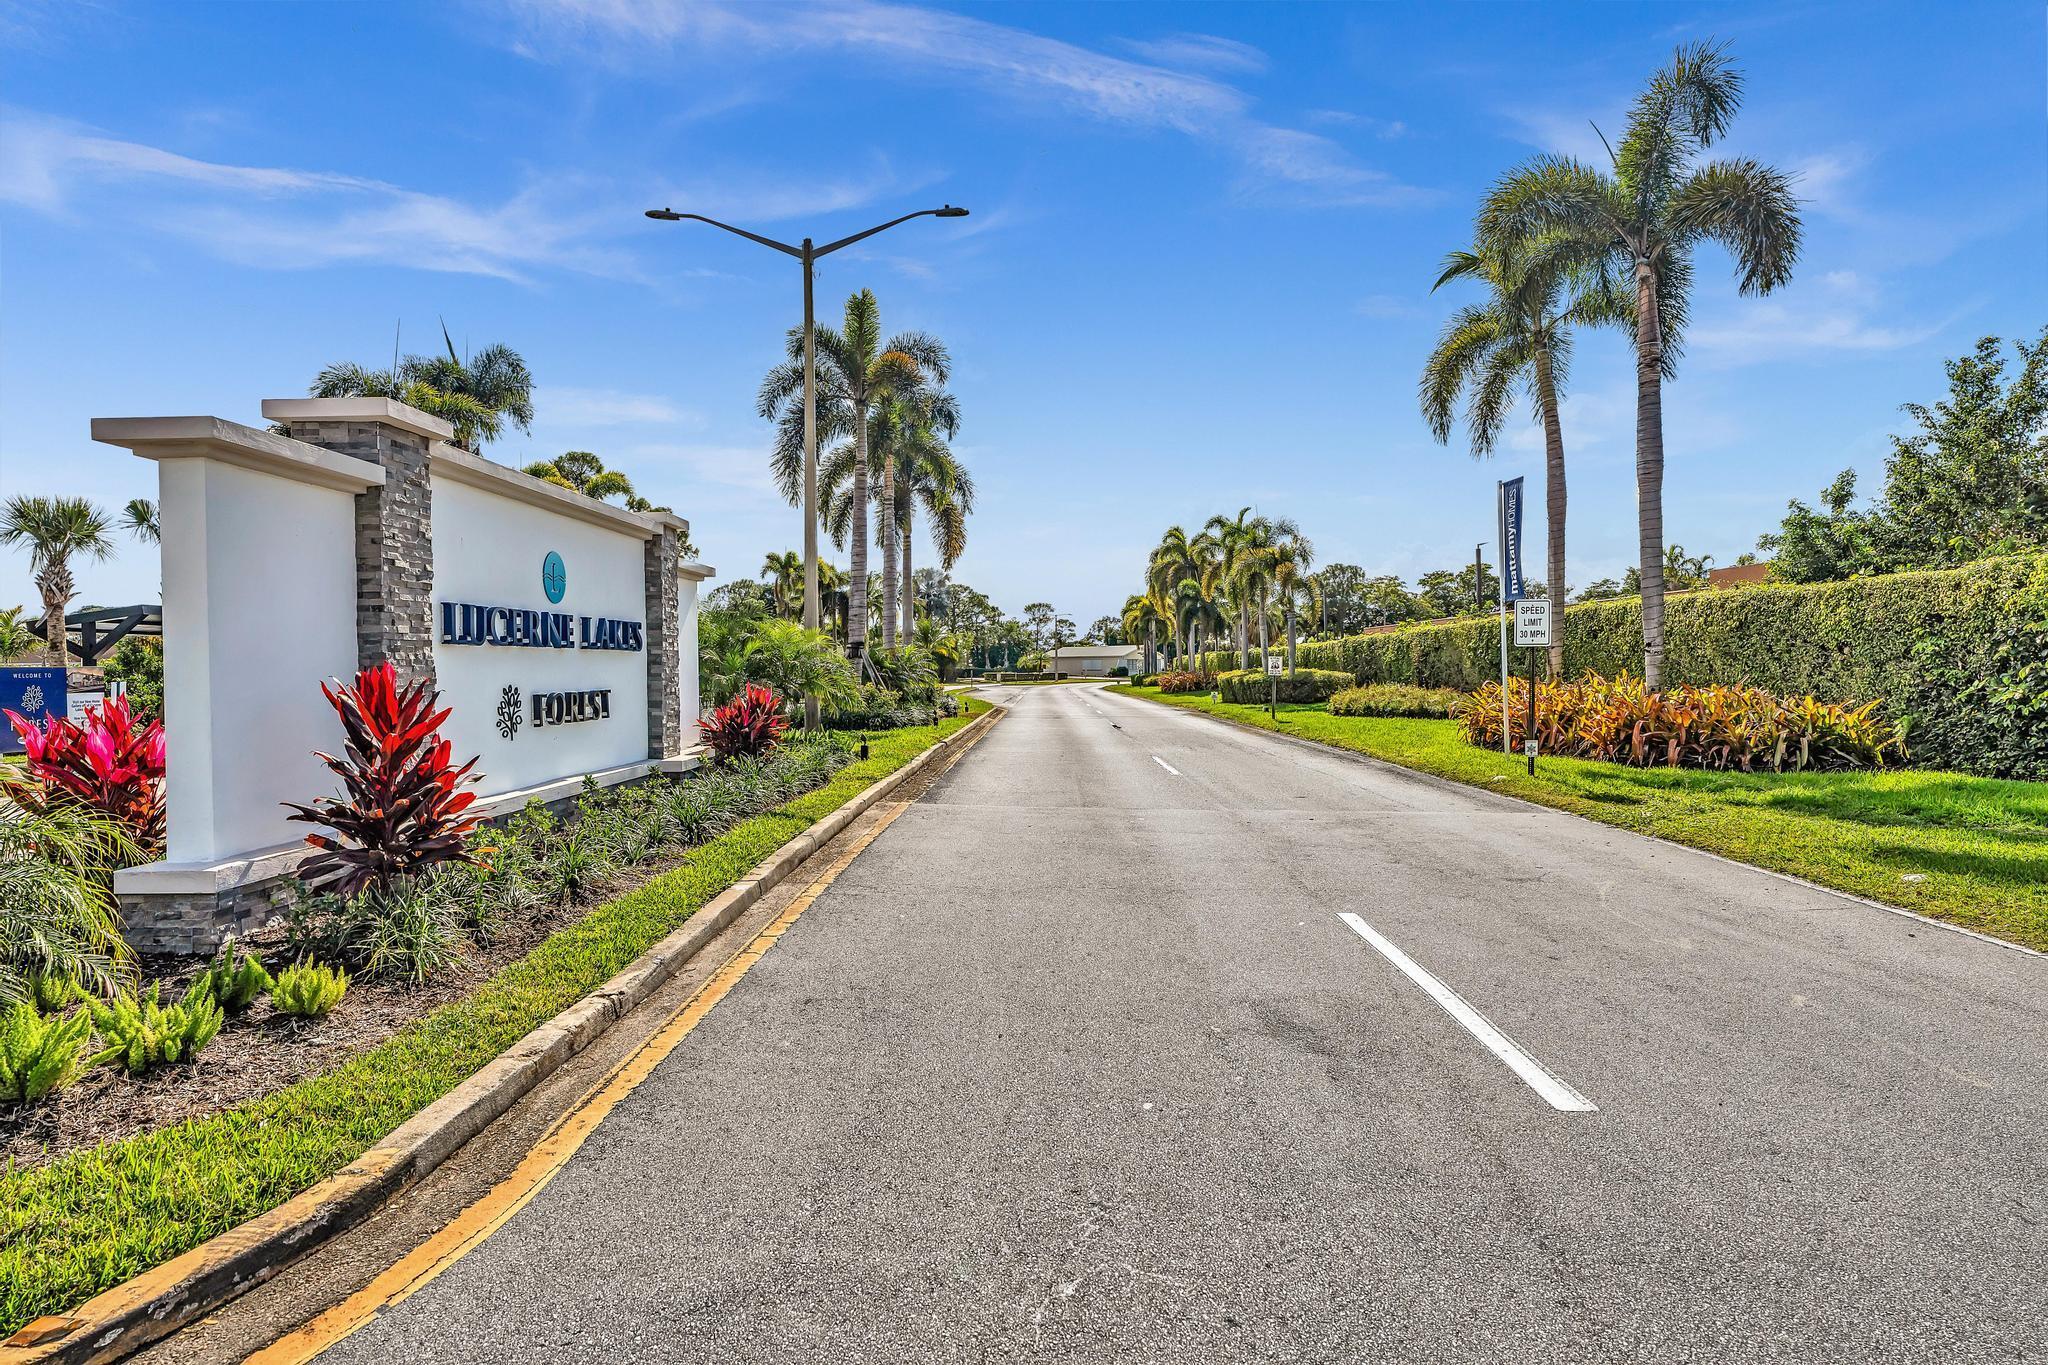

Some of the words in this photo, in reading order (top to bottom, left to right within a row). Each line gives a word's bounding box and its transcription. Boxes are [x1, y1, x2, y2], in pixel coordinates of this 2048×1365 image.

[1520, 606, 1545, 614] SPEED
[1523, 618, 1542, 626] LIMIT
[441, 602, 575, 648] LUCERNE
[579, 617, 643, 651] LAKES
[1520, 630, 1528, 638] 30
[1530, 630, 1546, 638] MPH
[531, 689, 611, 727] FOREST
